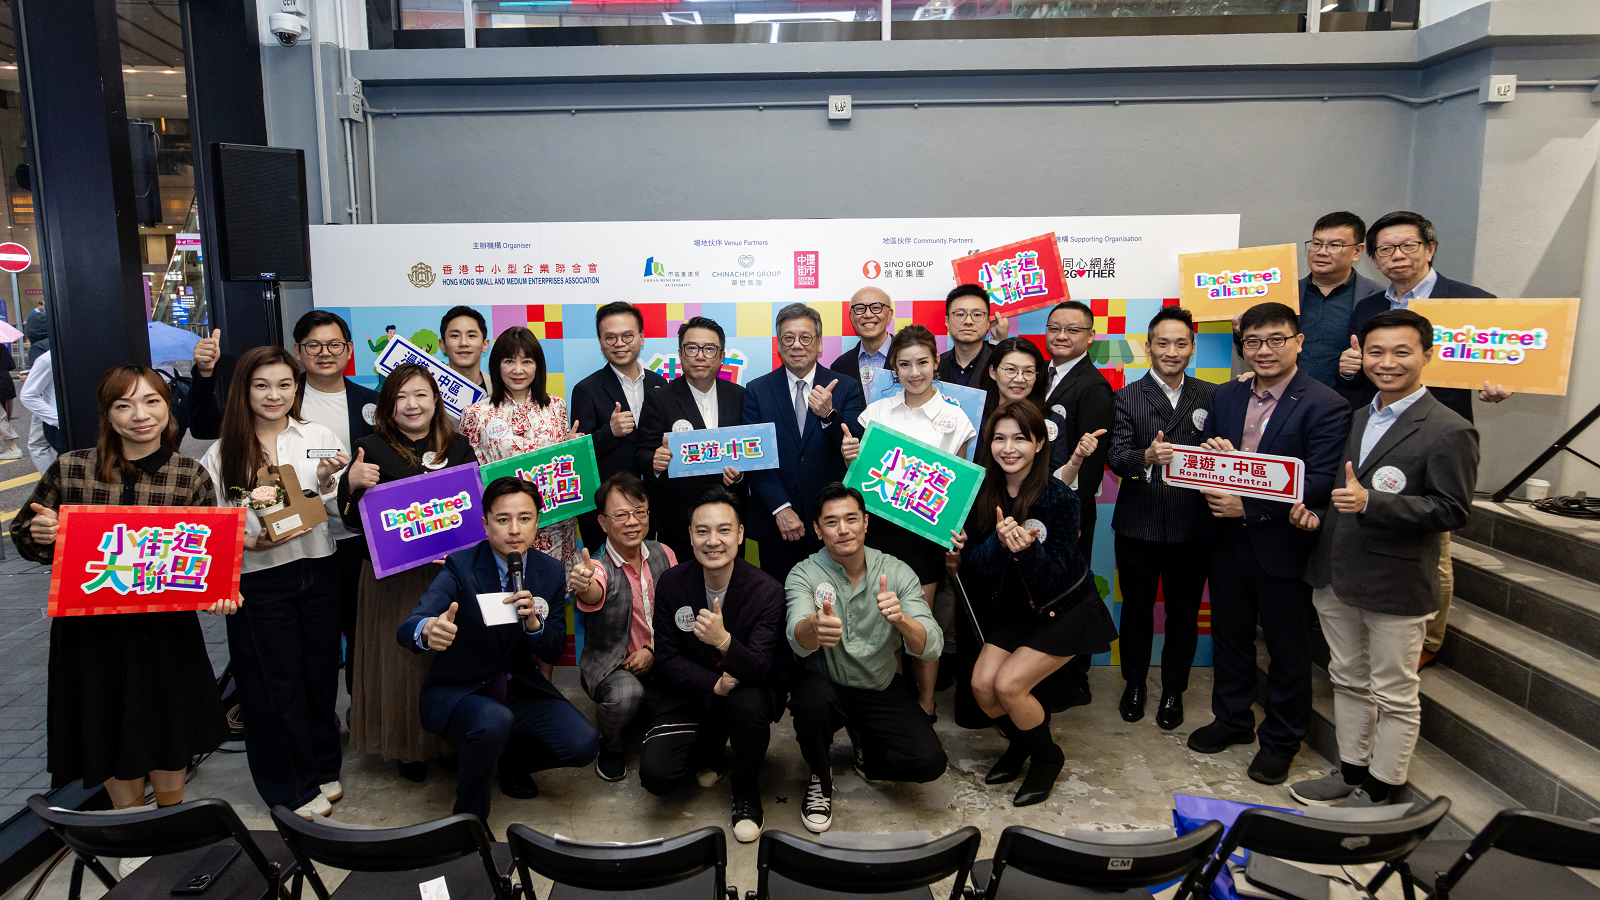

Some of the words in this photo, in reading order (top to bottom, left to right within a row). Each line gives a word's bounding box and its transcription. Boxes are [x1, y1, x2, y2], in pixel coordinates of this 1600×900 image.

[503, 242, 531, 250] Organiser
[913, 237, 947, 245] Community
[1104, 235, 1142, 243] Organisation
[442, 263, 598, 275] 香港中小型企業聯合會
[905, 260, 934, 268] GROUP
[980, 252, 1038, 282] 小街道
[1062, 257, 1116, 269] 同心網絡
[442, 278, 458, 286] HONG
[459, 278, 475, 286] KONG
[475, 278, 494, 286] SMALL
[494, 277, 506, 286] AND
[506, 277, 528, 285] MEDIUM
[528, 276, 564, 285] ENTERPRISES
[564, 276, 600, 285] ASSOCIATION
[884, 269, 924, 278] 信和集團
[1196, 269, 1279, 287] Backstreet
[1209, 284, 1266, 298] alliance
[1432, 328, 1543, 346] Backstreet
[1441, 343, 1521, 362] alliance
[881, 448, 955, 494] 小街道
[1179, 468, 1225, 483] Roaming
[1228, 475, 1272, 488] Central
[862, 467, 948, 523] 大聯盟
[383, 494, 469, 528] Backstreet
[402, 514, 460, 539] alliance
[101, 524, 208, 560] 小街道
[84, 554, 209, 593] 大聯盟
[1110, 859, 1131, 868] CM
